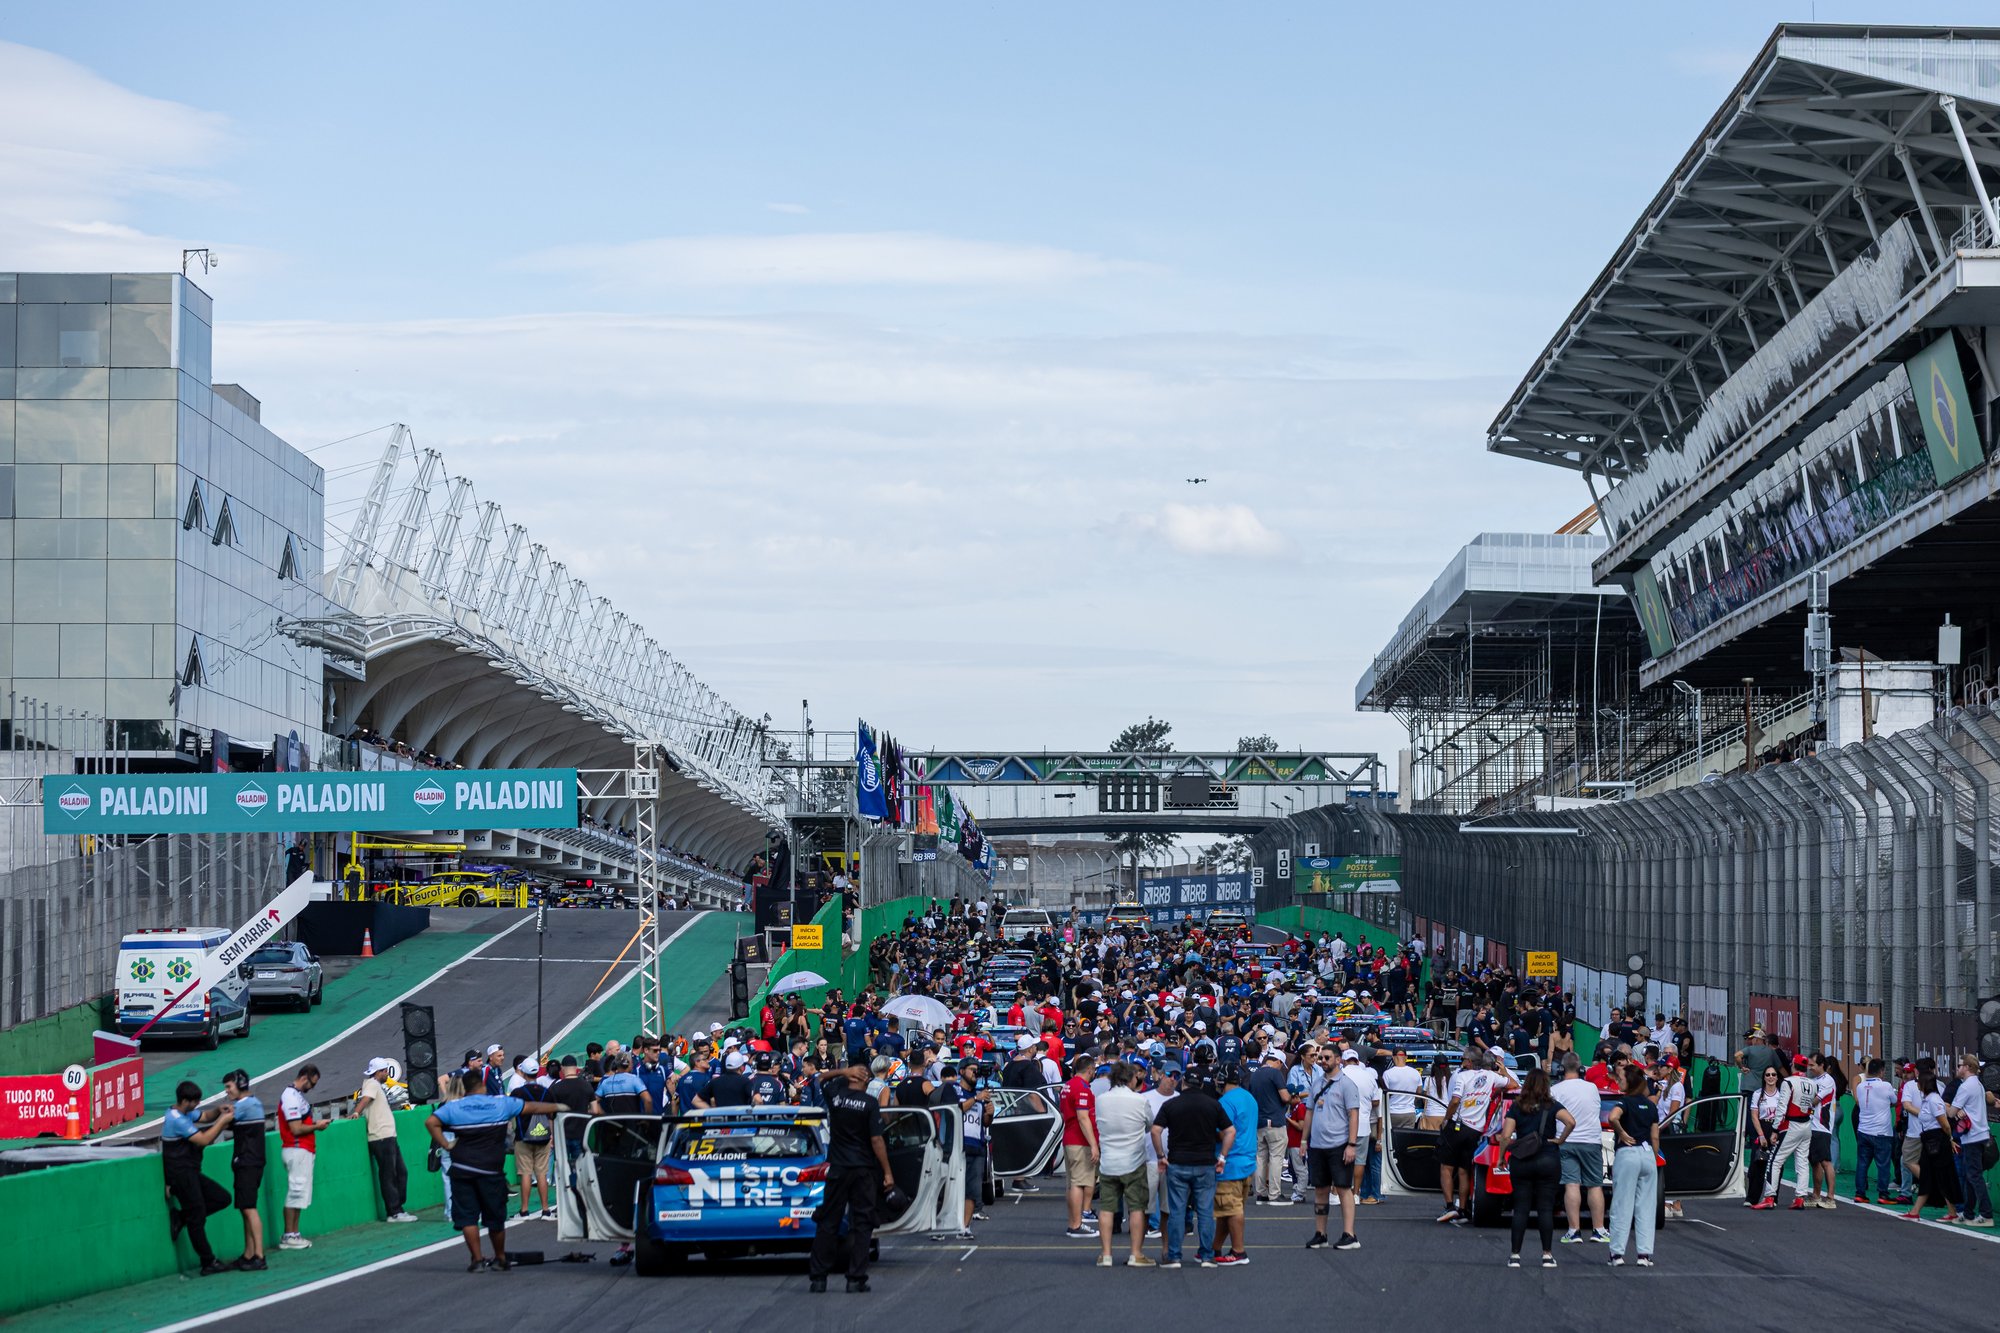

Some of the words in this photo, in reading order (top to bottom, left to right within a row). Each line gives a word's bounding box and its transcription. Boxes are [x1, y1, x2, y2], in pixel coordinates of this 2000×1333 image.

[1247, 767, 1295, 775] PETRRAS
[60, 797, 89, 806] PALADINI
[100, 786, 207, 816] PALADINI
[237, 794, 267, 803] PALADINI
[277, 783, 385, 813] PALADINI
[415, 791, 445, 801] PALADINI
[455, 780, 563, 811] PALADINI
[1310, 845, 1316, 855] 1
[1153, 885, 1170, 904] BRB
[1189, 883, 1207, 902] BRB
[1224, 881, 1241, 900] BRB
[219, 941, 242, 966] SEM
[241, 917, 273, 951] PARAR
[171, 1002, 199, 1010] 205-6639
[67, 1070, 81, 1085] 60
[5, 1089, 32, 1104] TUDO
[35, 1088, 55, 1103] PRO
[18, 1104, 36, 1119] SEU
[38, 1103, 69, 1118] CARRO
[688, 1138, 715, 1155] 15
[744, 1187, 784, 1206] RE
